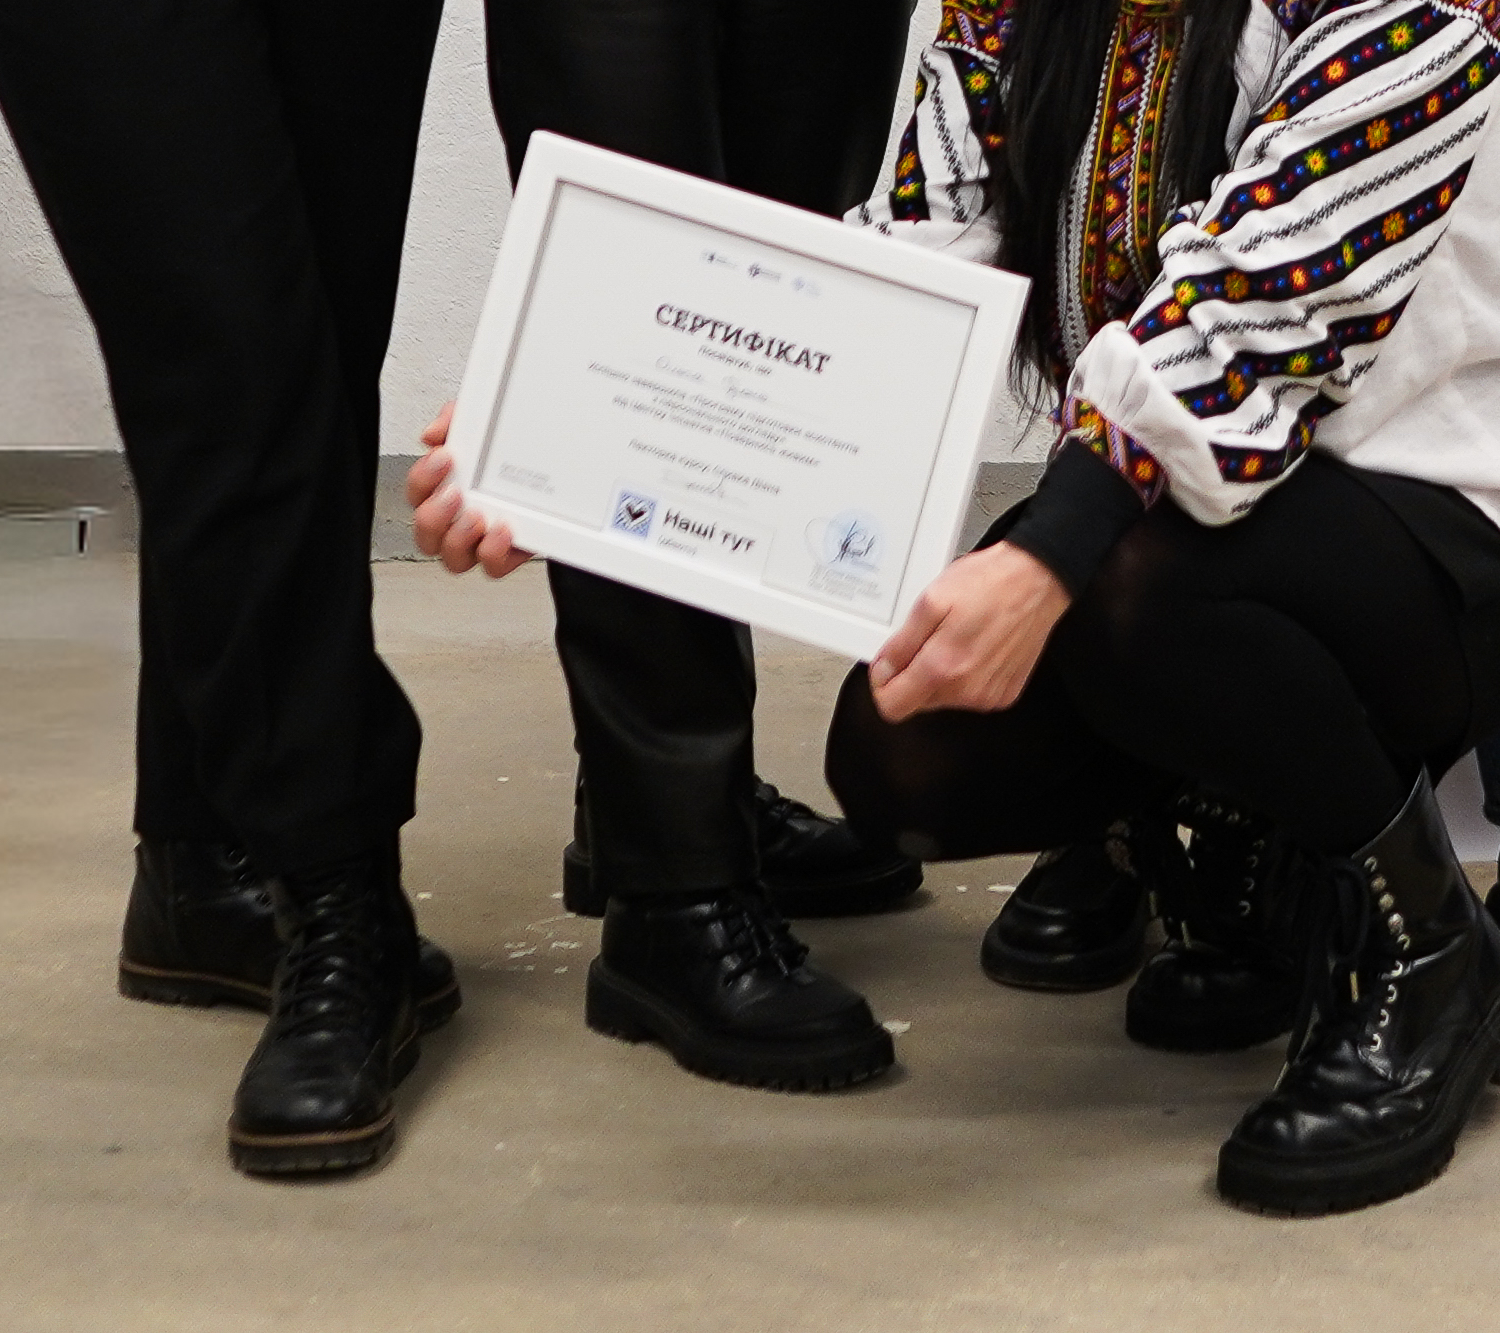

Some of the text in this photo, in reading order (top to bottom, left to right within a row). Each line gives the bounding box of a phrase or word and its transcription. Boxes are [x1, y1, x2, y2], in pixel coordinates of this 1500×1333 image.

[654, 301, 833, 375] СЕРТИФІКАТ
[662, 507, 717, 540] Наші
[720, 527, 757, 555] тут
